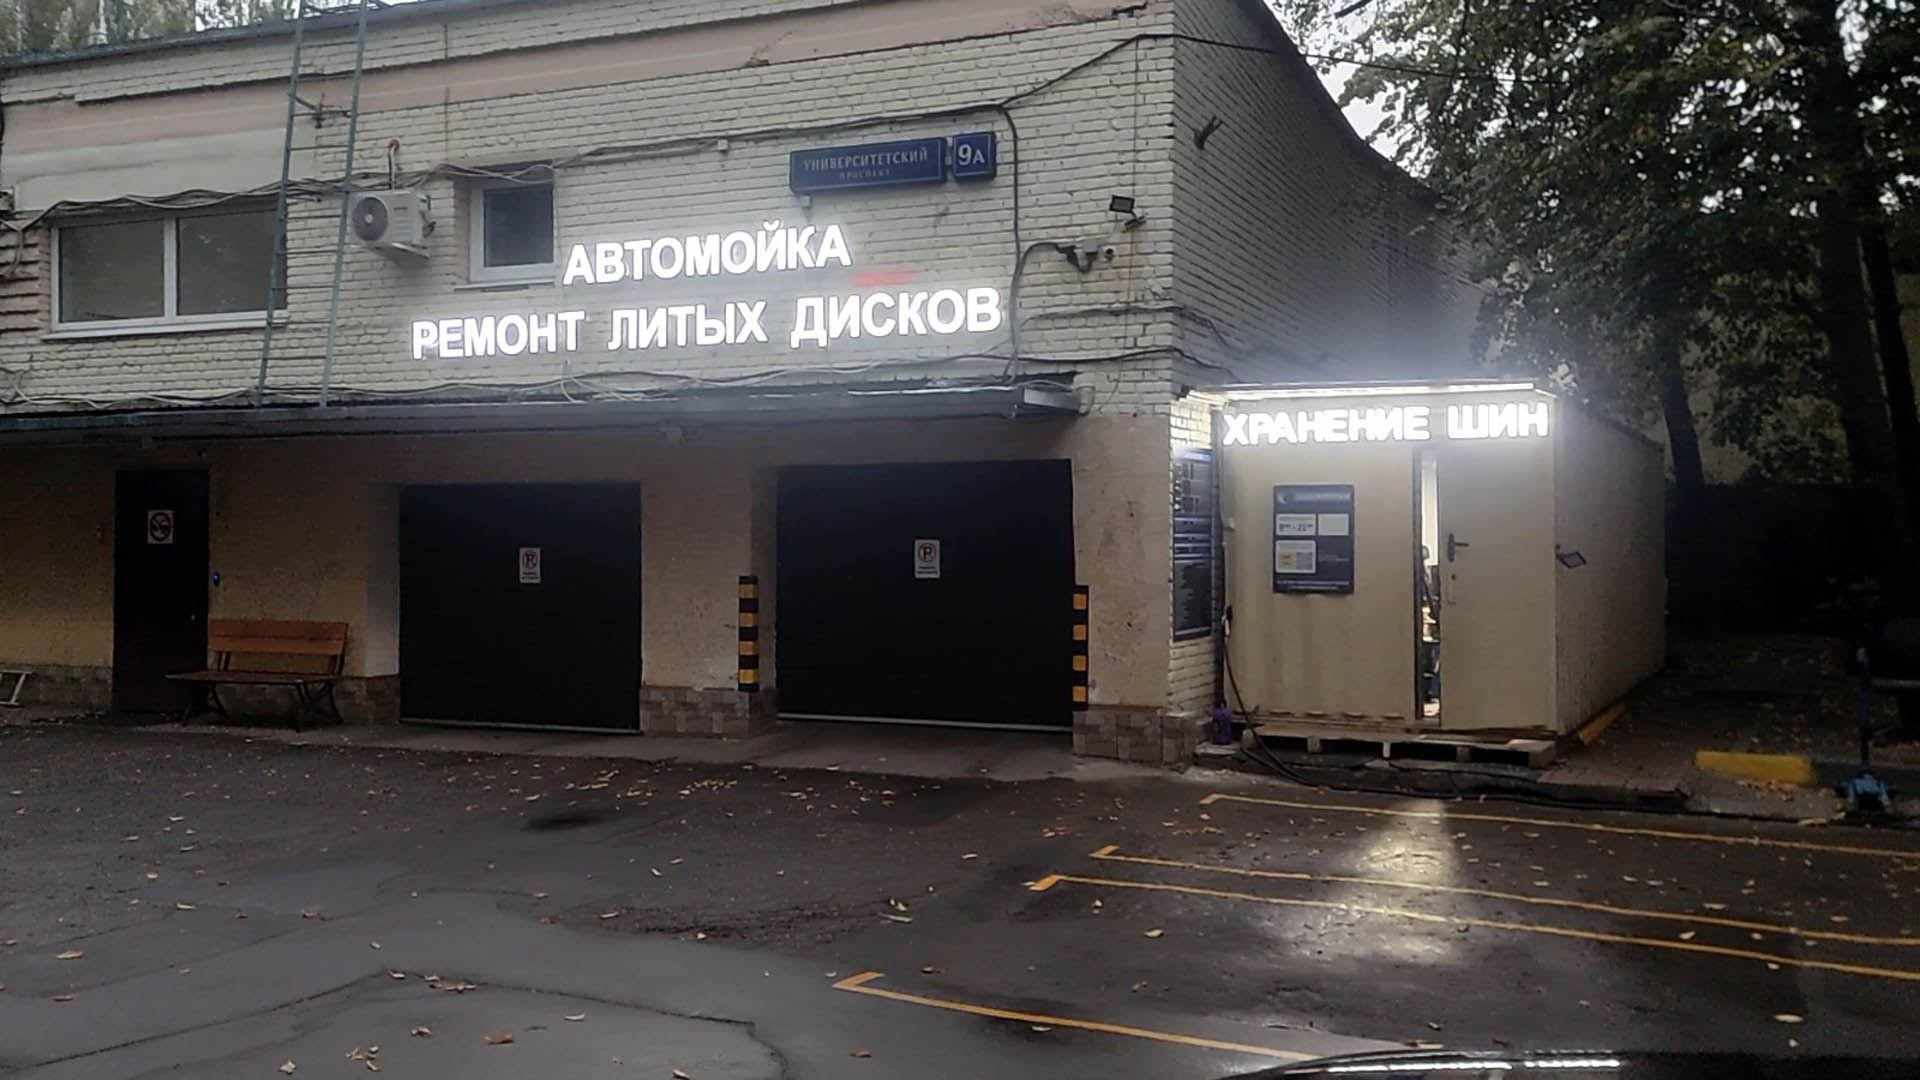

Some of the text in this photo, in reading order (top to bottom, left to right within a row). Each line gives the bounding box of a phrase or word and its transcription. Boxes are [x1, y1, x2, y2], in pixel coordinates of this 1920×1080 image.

[803, 147, 928, 171] УНИВЕРСИТЕТСКИЙ
[958, 144, 986, 166] 9А
[562, 219, 852, 286] АВТОМОЙКА
[411, 287, 1002, 361] РЕМОНТ ЛИТЫХ ДИСКОВ
[1222, 402, 1549, 446] ХРАНЕНИЕ ШИН
